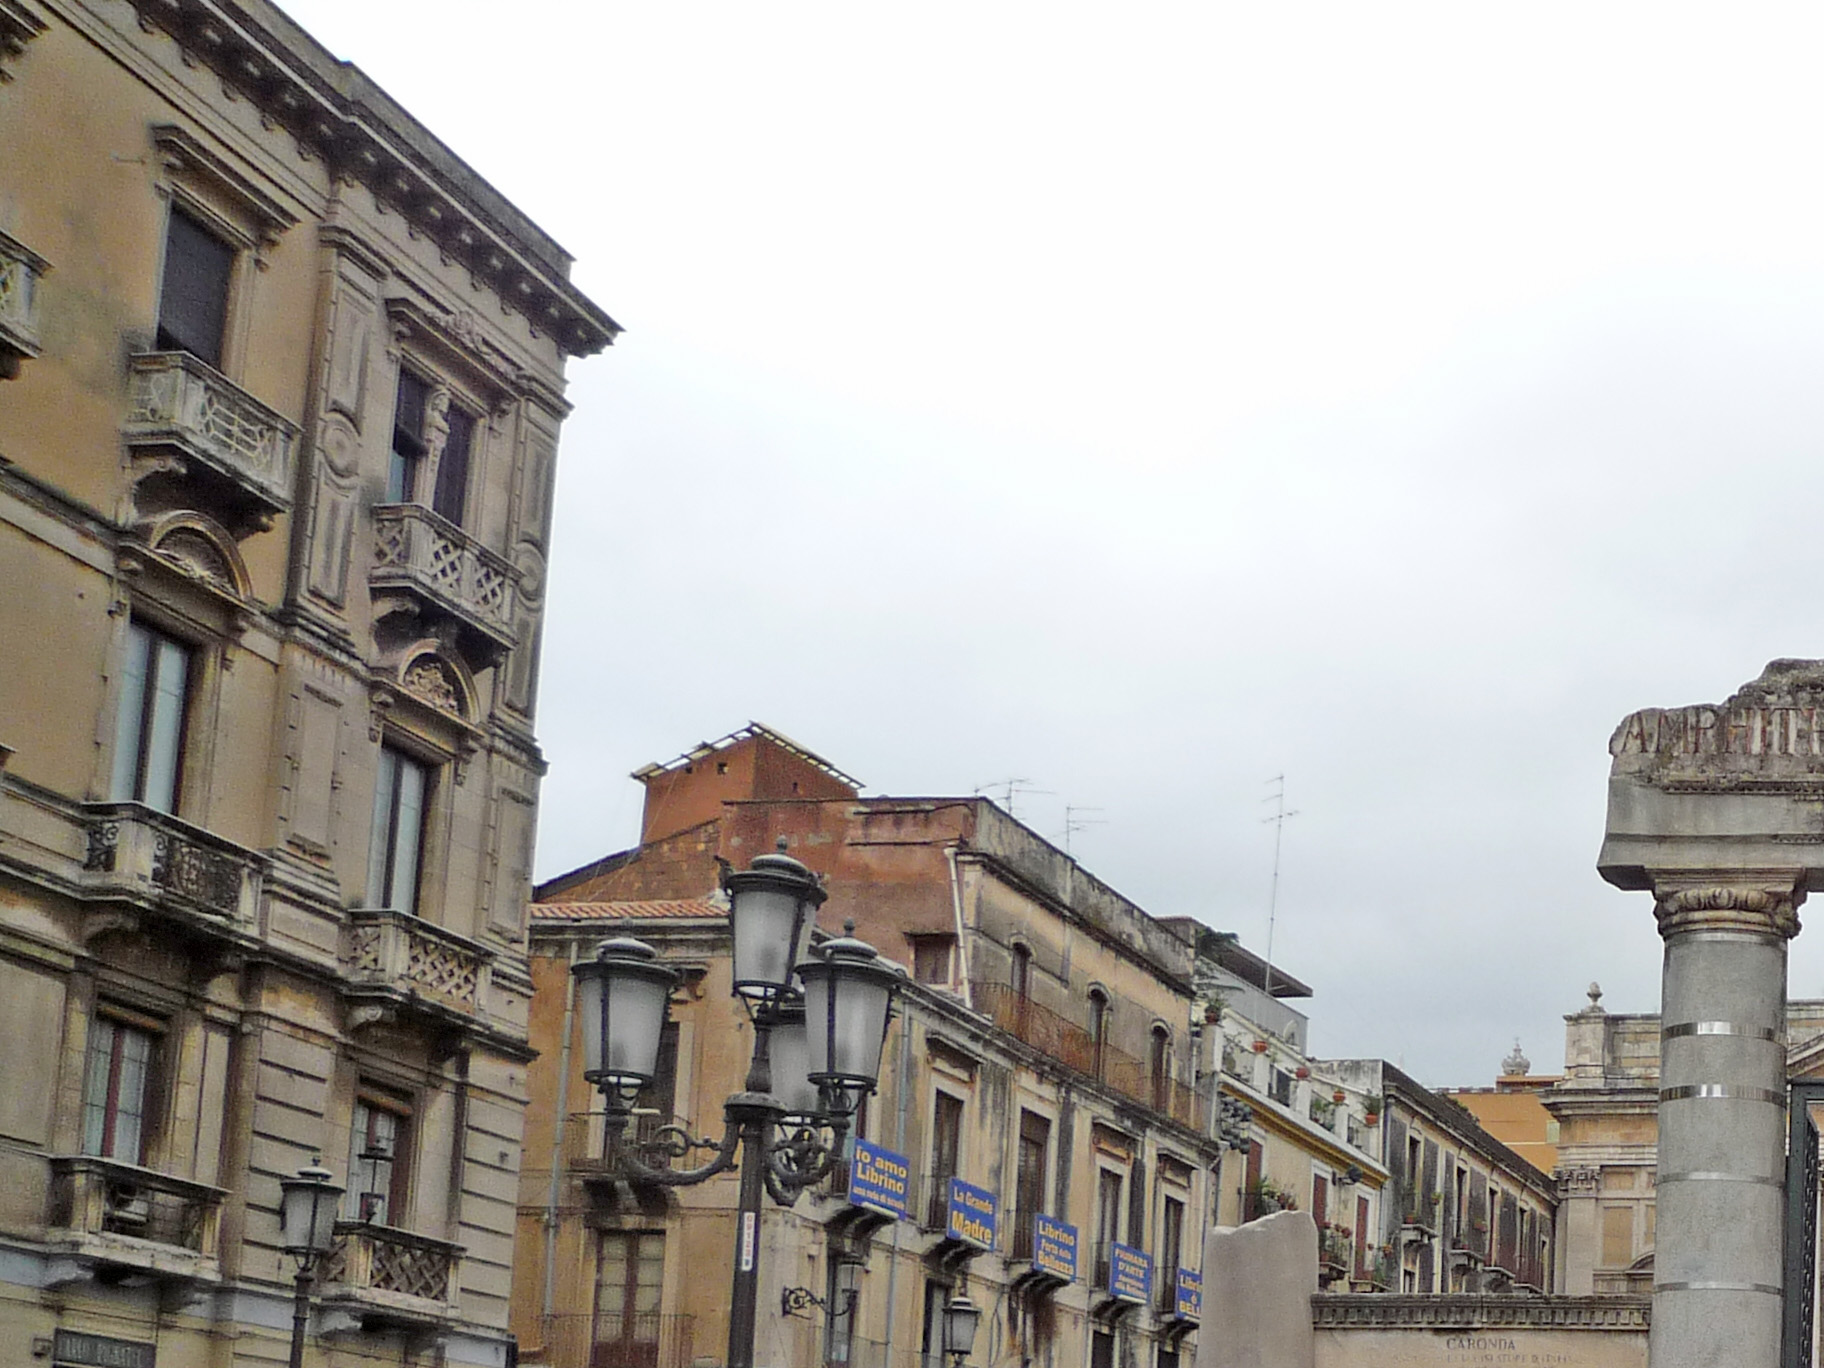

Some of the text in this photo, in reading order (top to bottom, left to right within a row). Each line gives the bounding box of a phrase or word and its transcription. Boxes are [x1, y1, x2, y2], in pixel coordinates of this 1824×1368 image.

[856, 1162, 905, 1195] Librino
[874, 1156, 908, 1179] amo
[953, 1186, 994, 1215] La Grande
[952, 1210, 993, 1245] Madre
[1038, 1220, 1075, 1247] Librino
[1446, 1337, 1517, 1351] CARONDA
